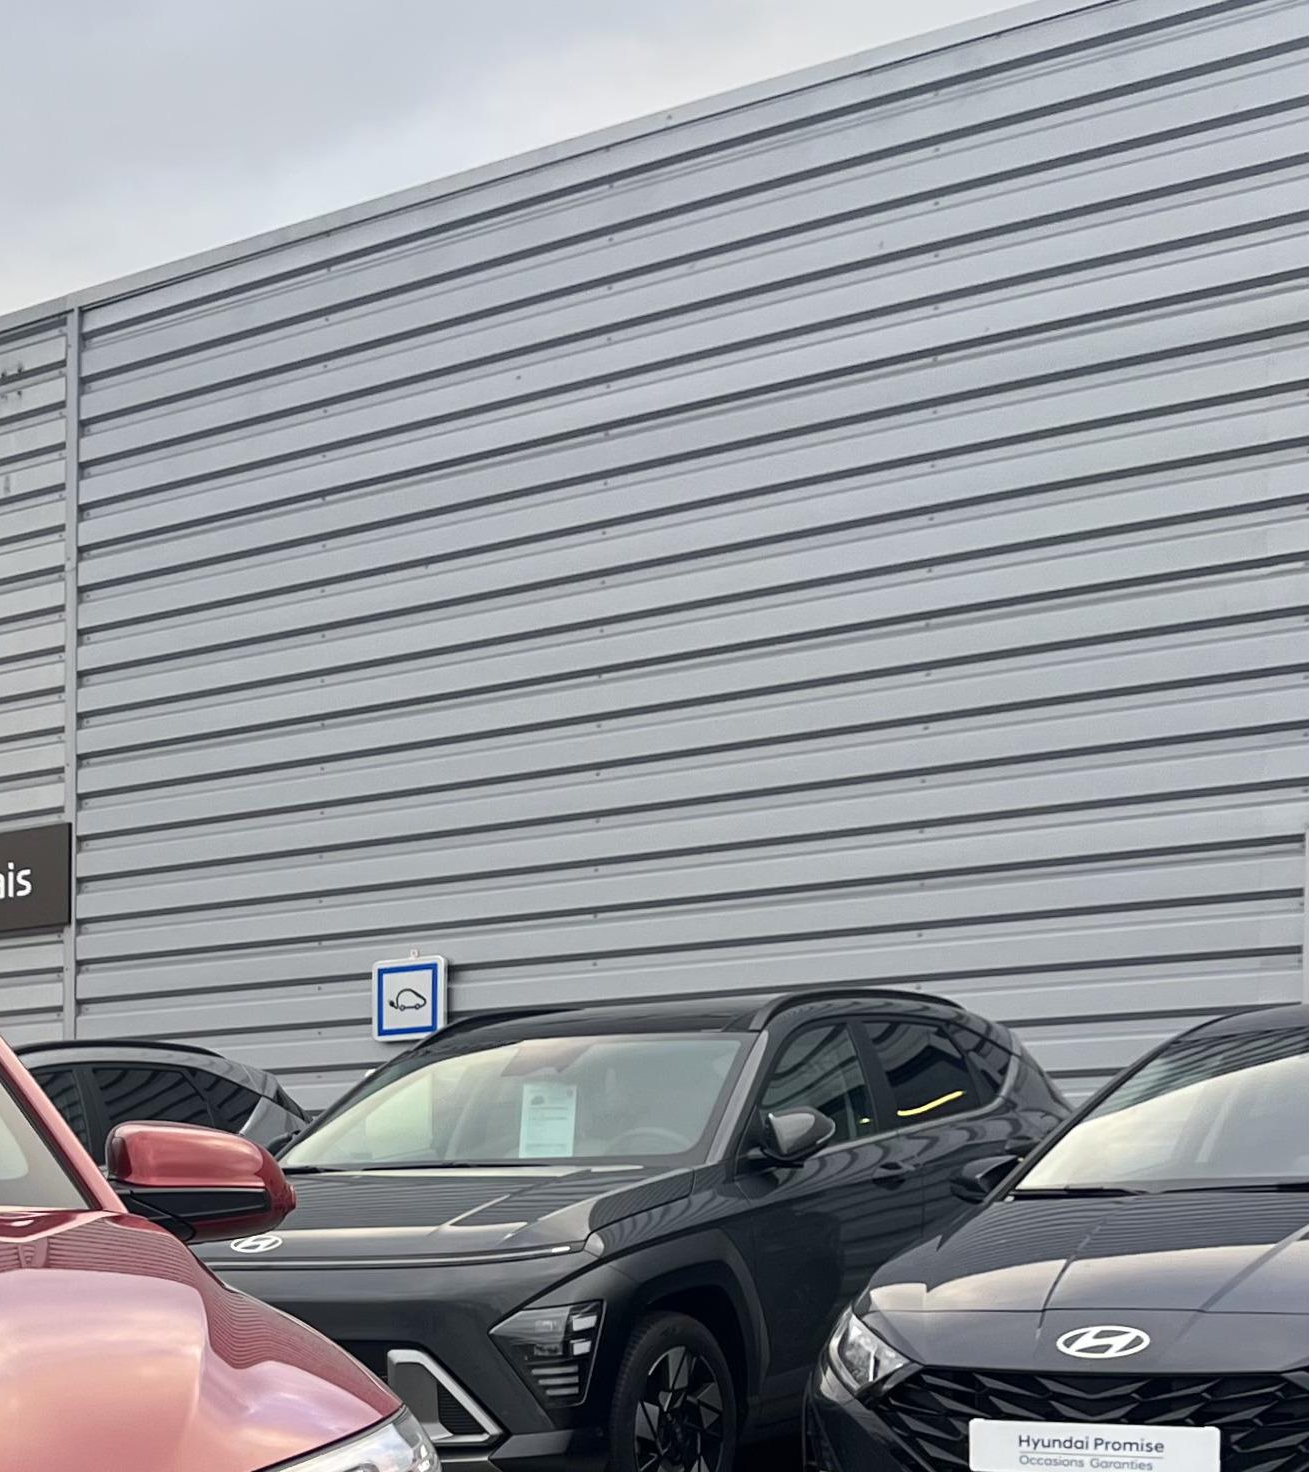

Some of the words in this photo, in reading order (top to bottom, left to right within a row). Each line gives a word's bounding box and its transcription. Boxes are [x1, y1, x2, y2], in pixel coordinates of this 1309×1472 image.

[1018, 1434, 1089, 1451] Hyundai
[1093, 1437, 1165, 1453] Promise
[1018, 1454, 1084, 1468] Occasions
[1089, 1457, 1154, 1471] Garanties
